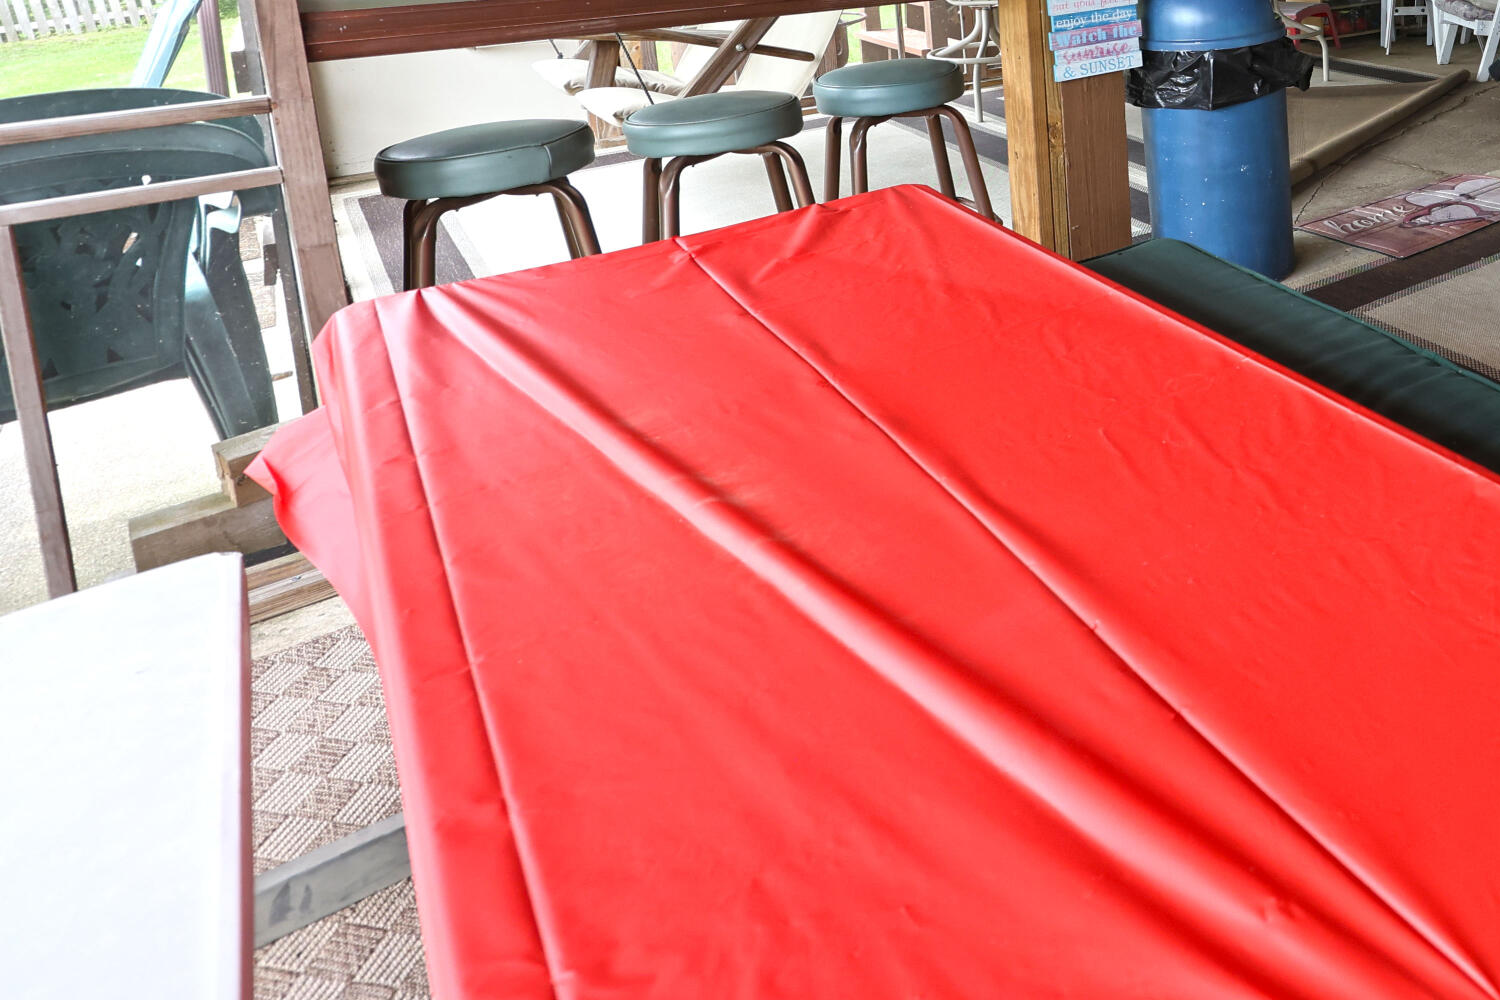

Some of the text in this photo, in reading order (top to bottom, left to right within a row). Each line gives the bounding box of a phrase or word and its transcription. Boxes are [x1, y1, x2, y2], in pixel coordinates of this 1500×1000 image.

[1055, 9, 1133, 29] enjoy the day
[1055, 25, 1137, 47] Watch the
[1063, 55, 1135, 79] & SUNSET
[1323, 204, 1416, 234] home
